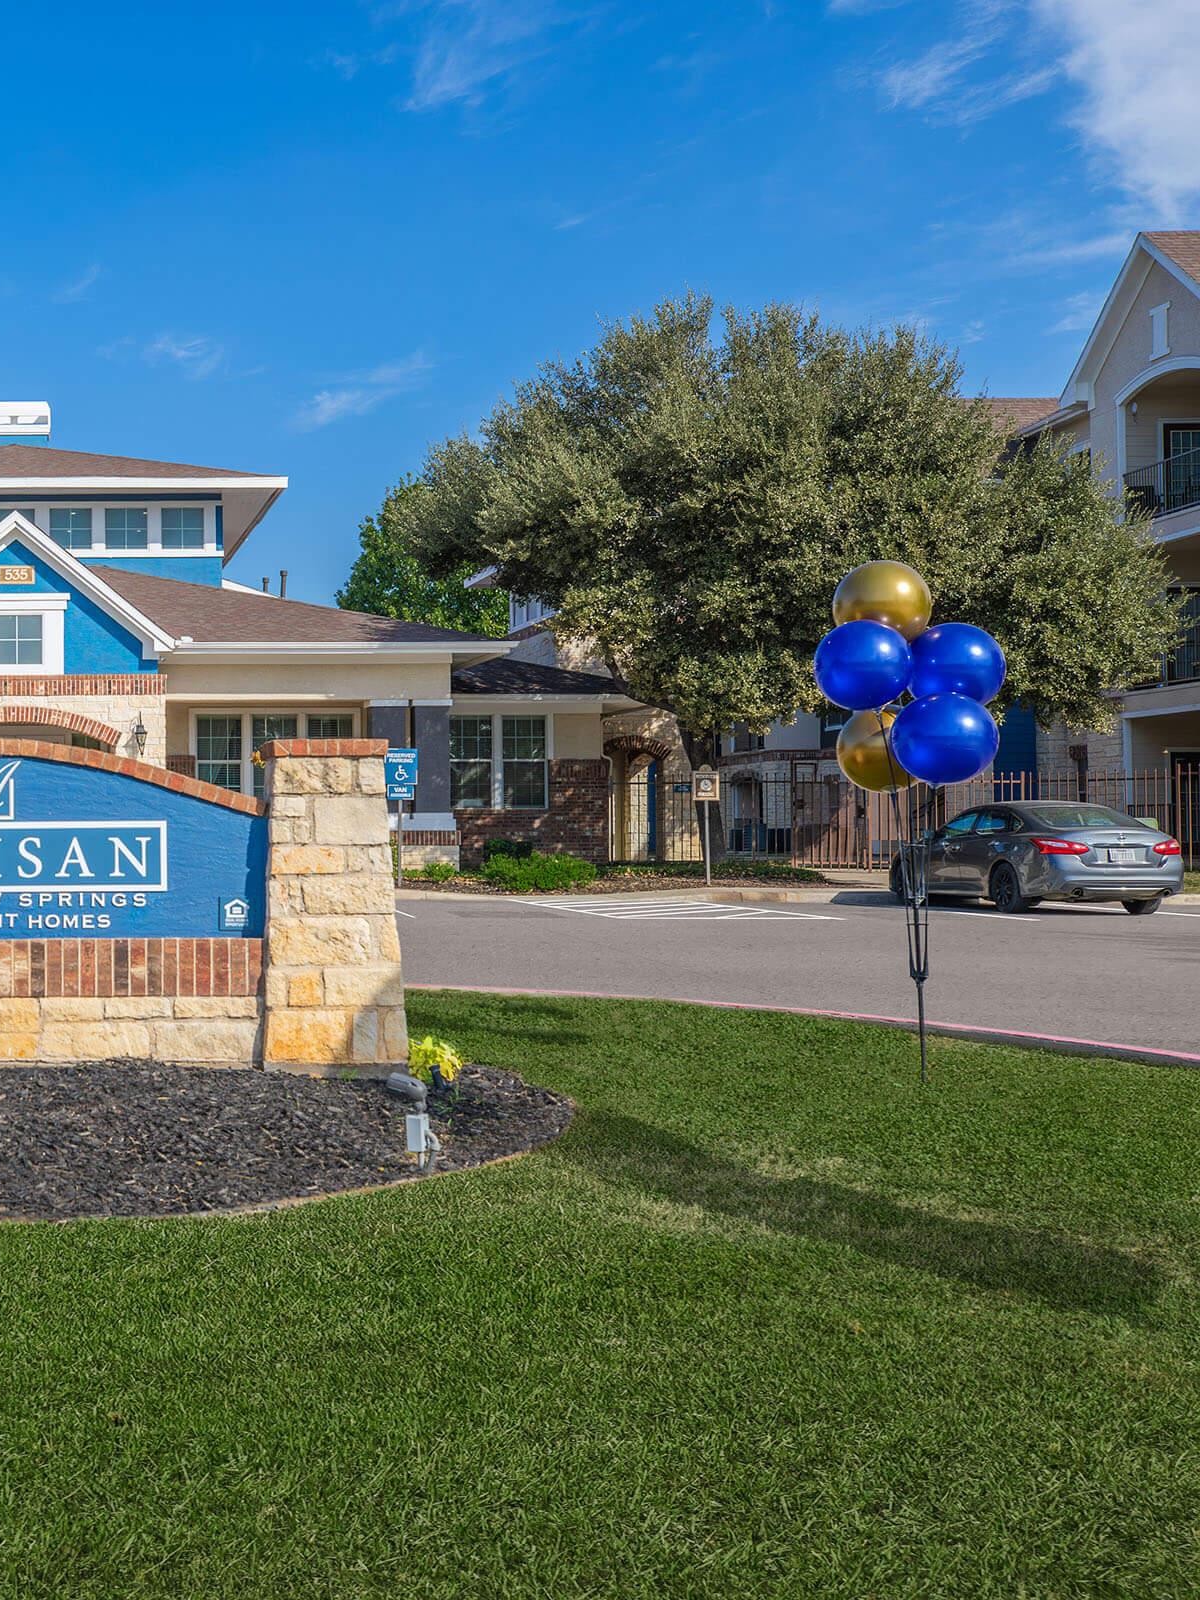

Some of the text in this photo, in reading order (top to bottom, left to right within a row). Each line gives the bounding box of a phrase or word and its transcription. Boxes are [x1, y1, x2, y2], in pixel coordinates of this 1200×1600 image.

[4, 569, 28, 580] 535
[19, 892, 147, 907] SPRINGS
[28, 914, 111, 929] HOMES
